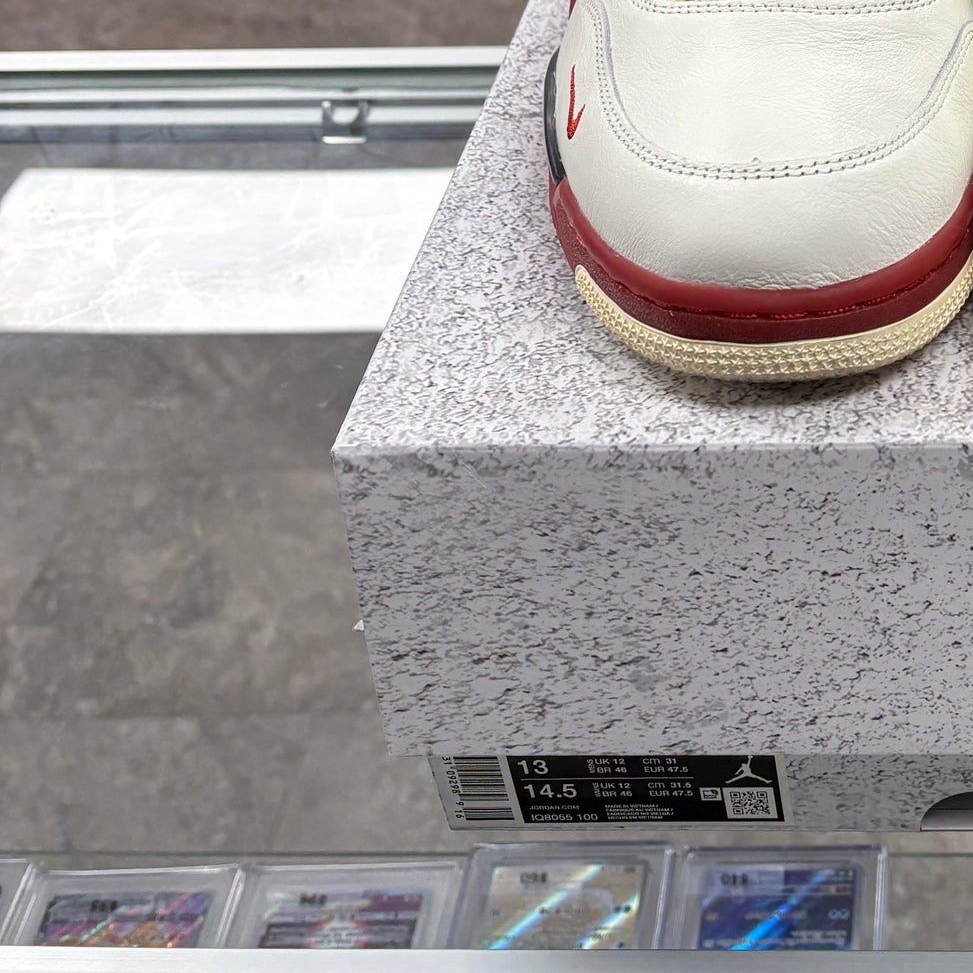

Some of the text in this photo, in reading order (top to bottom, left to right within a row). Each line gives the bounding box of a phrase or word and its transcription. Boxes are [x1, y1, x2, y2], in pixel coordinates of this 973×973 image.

[517, 759, 549, 775] 13
[523, 783, 578, 798] 14.5
[531, 813, 598, 821] IQ8055 100
